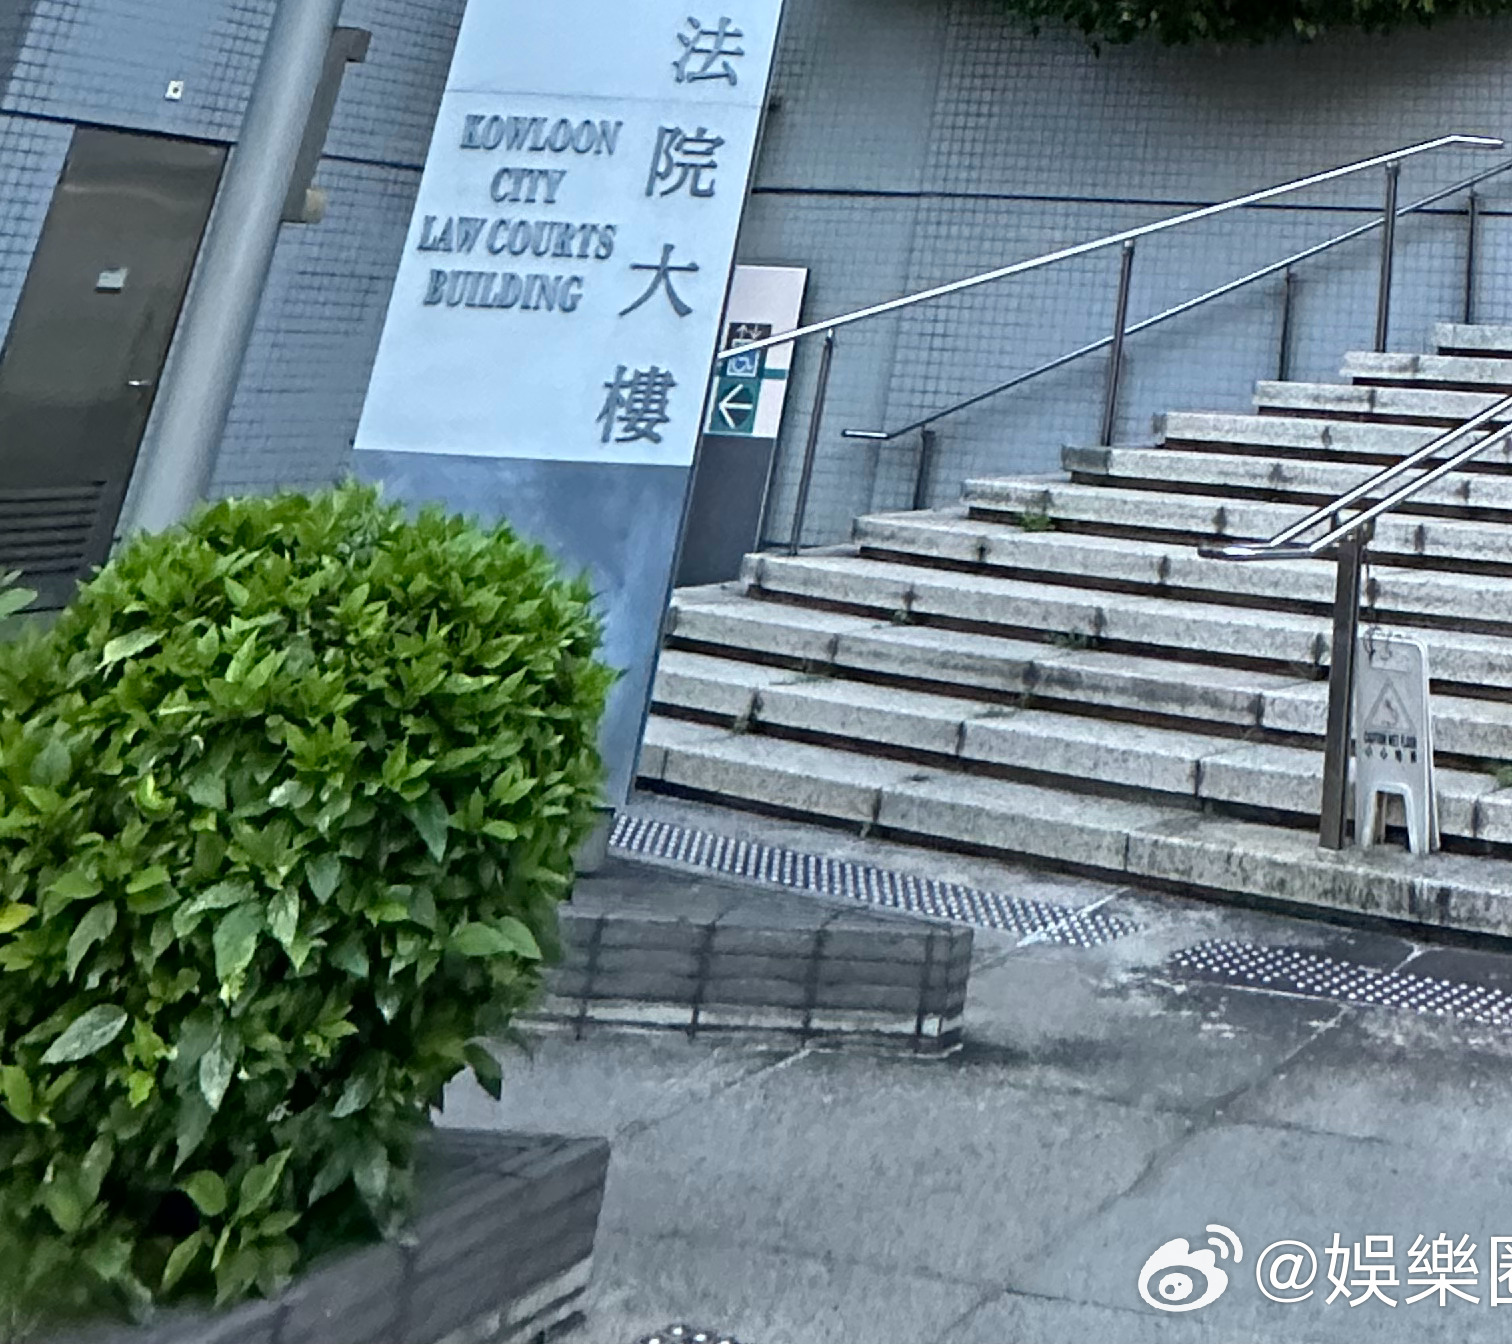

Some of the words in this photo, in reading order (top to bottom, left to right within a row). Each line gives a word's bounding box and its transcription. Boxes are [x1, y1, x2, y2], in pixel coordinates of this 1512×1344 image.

[459, 113, 623, 156] KOWLOON
[489, 166, 567, 204] CITY
[416, 214, 488, 254] LAW
[485, 217, 618, 260] COURTS
[422, 268, 584, 313] BUILDING
